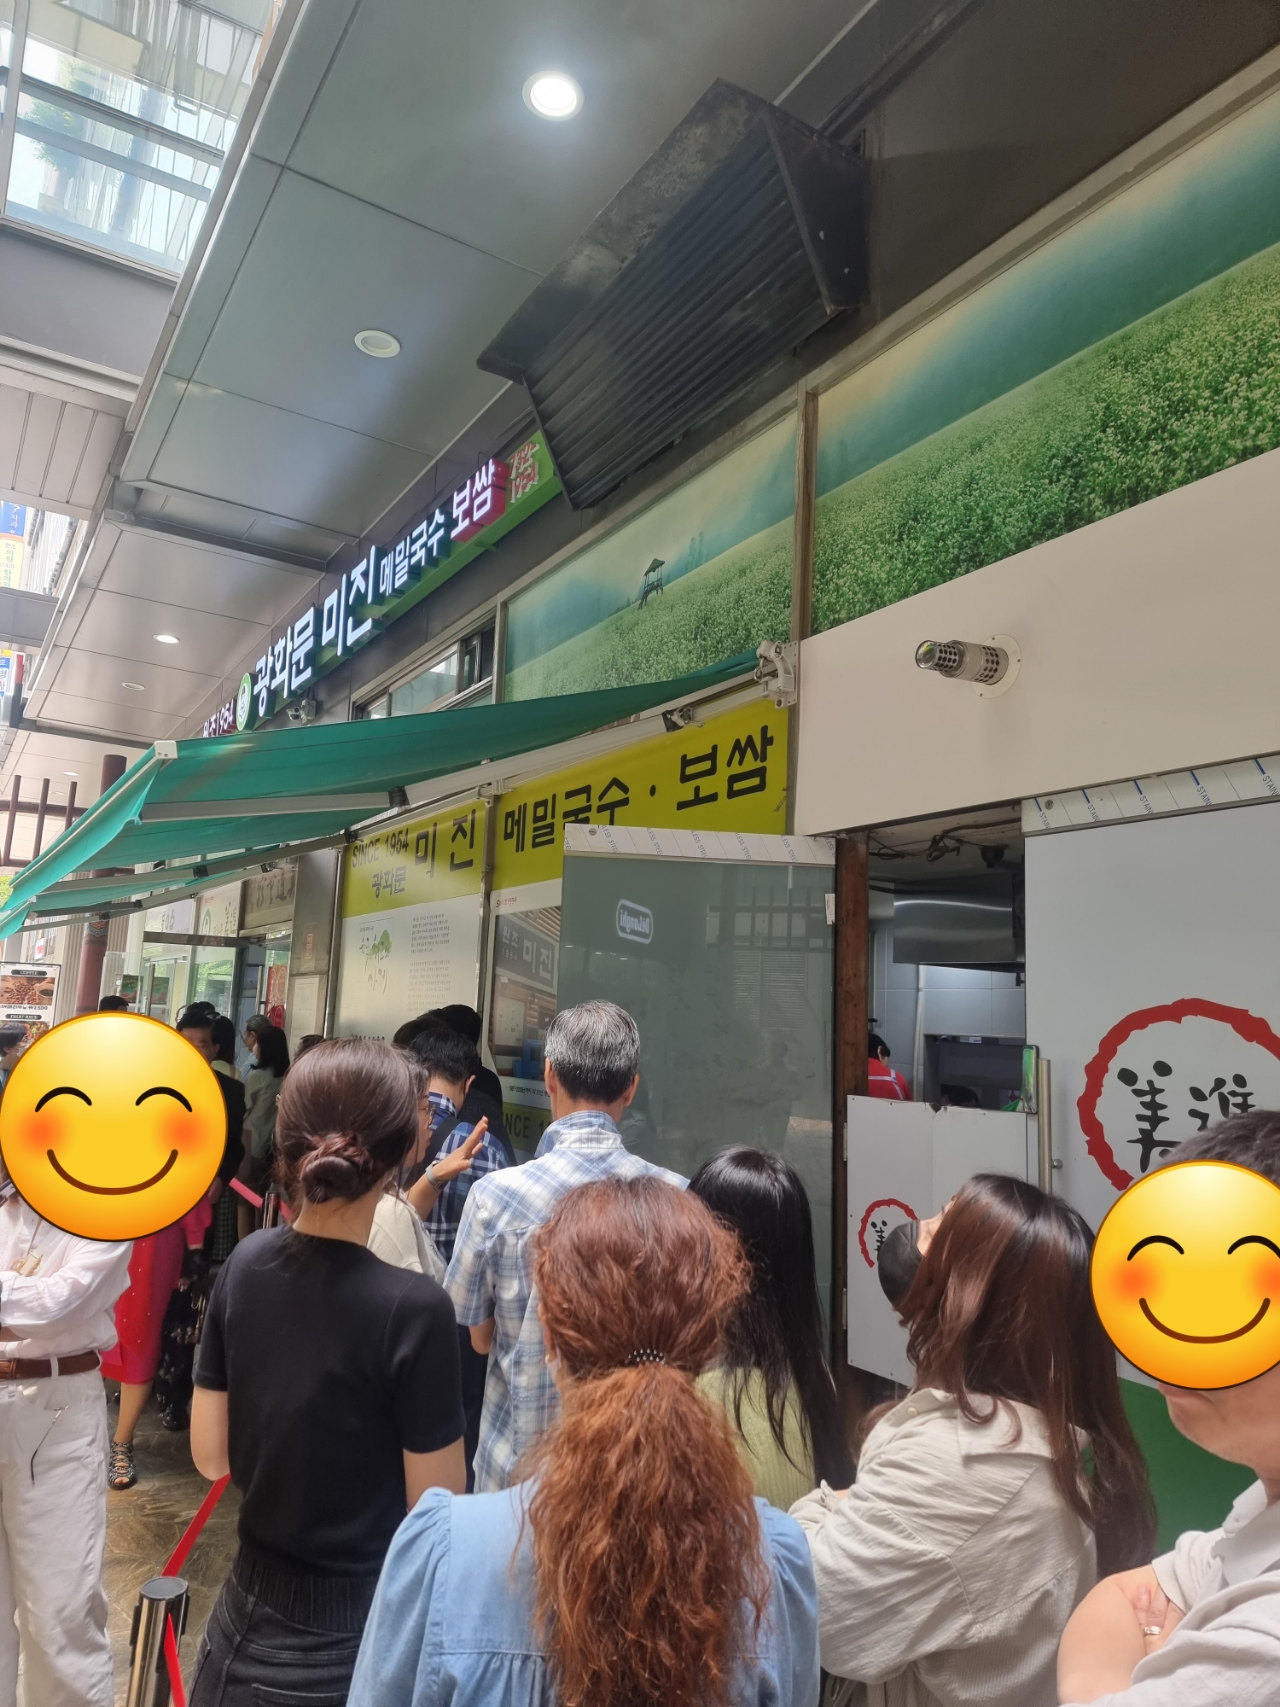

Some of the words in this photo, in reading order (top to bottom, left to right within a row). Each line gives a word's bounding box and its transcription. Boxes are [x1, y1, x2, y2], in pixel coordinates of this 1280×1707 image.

[253, 606, 314, 717] 광화문
[321, 544, 373, 656] 미진
[380, 508, 445, 596] 메밀국수
[451, 458, 496, 540] 보쌈
[503, 777, 630, 853] 메밀국수
[676, 724, 774, 811] 보쌈
[352, 838, 380, 868] SINCE
[384, 828, 410, 858] 1954
[372, 865, 407, 898] 광화문
[502, 926, 519, 947] 원조
[522, 939, 553, 980] 미진
